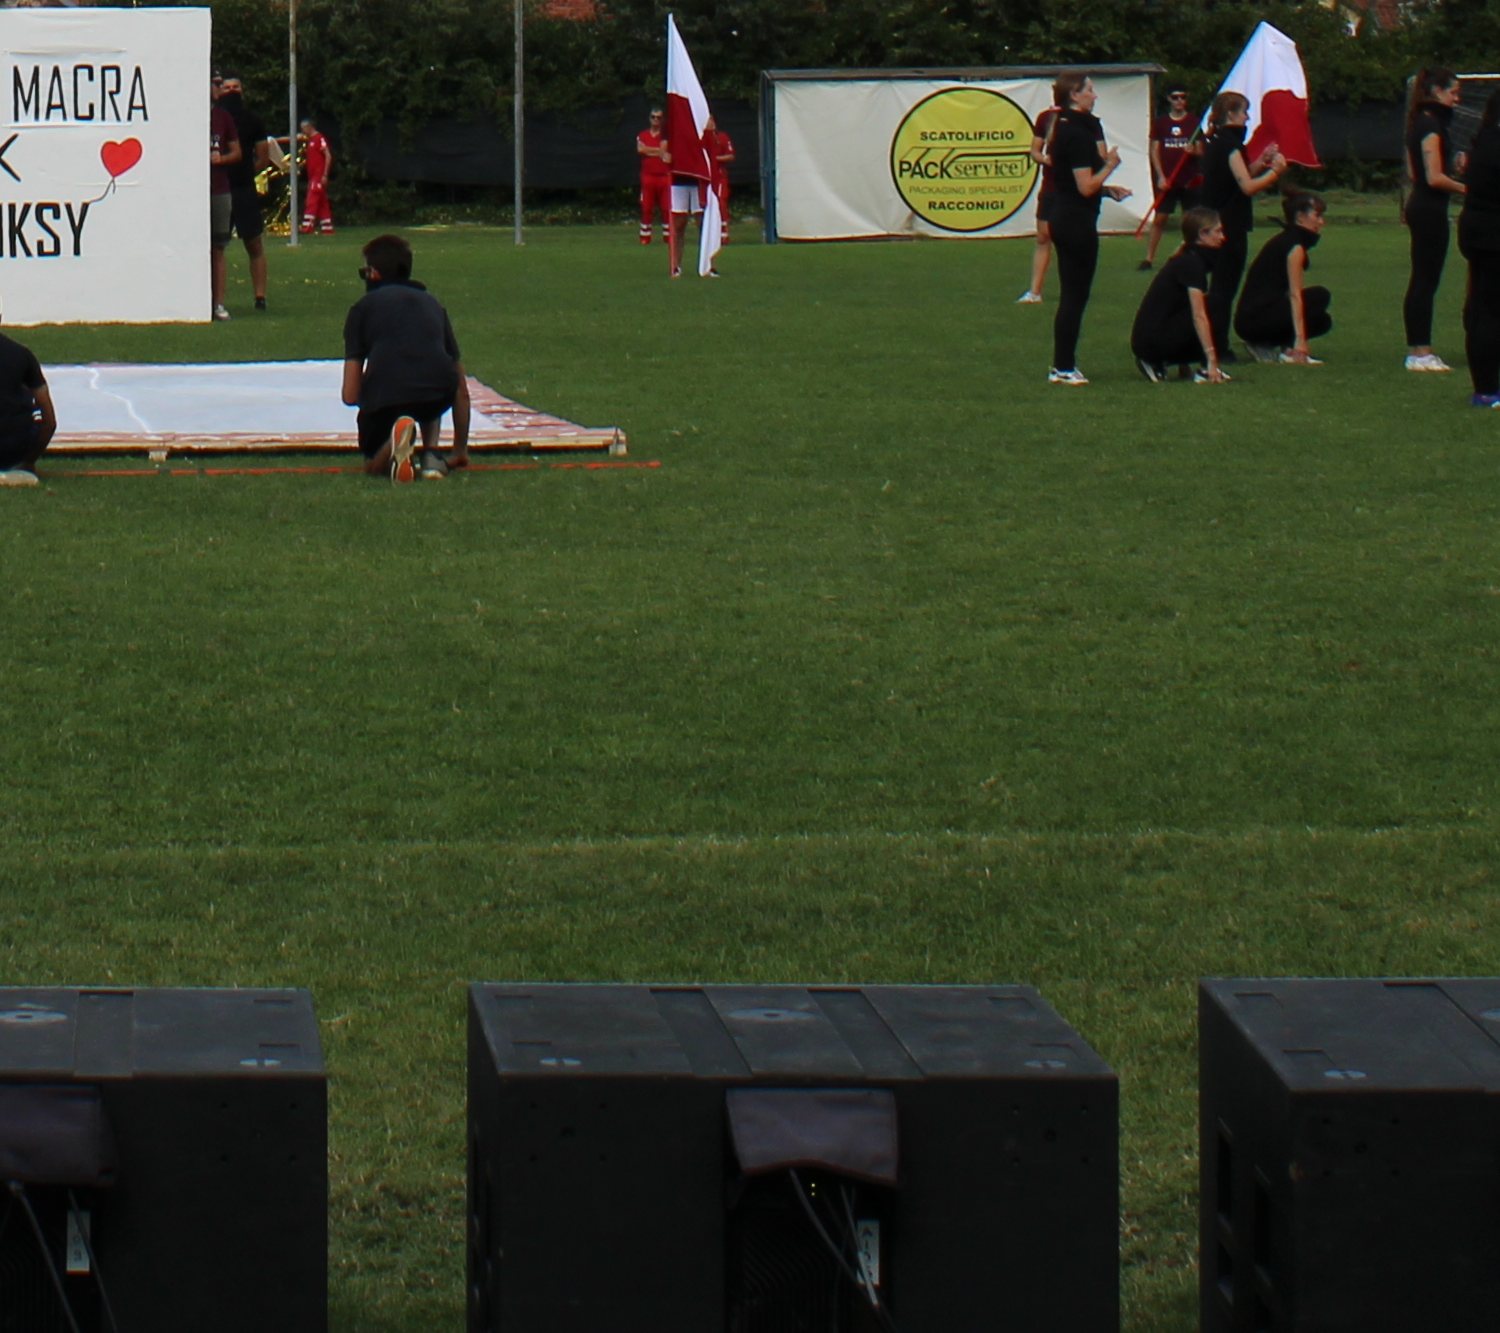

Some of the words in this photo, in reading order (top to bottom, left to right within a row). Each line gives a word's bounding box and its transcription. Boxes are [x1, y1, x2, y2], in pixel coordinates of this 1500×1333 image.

[13, 64, 150, 123] MACRA
[919, 130, 1015, 141] SCATOLIFICIO
[898, 160, 953, 180] PACK
[954, 159, 1018, 177] service
[908, 185, 966, 195] PACKAGING
[968, 184, 1024, 194] SPECIALIST
[927, 200, 1005, 211] RACCONIGI
